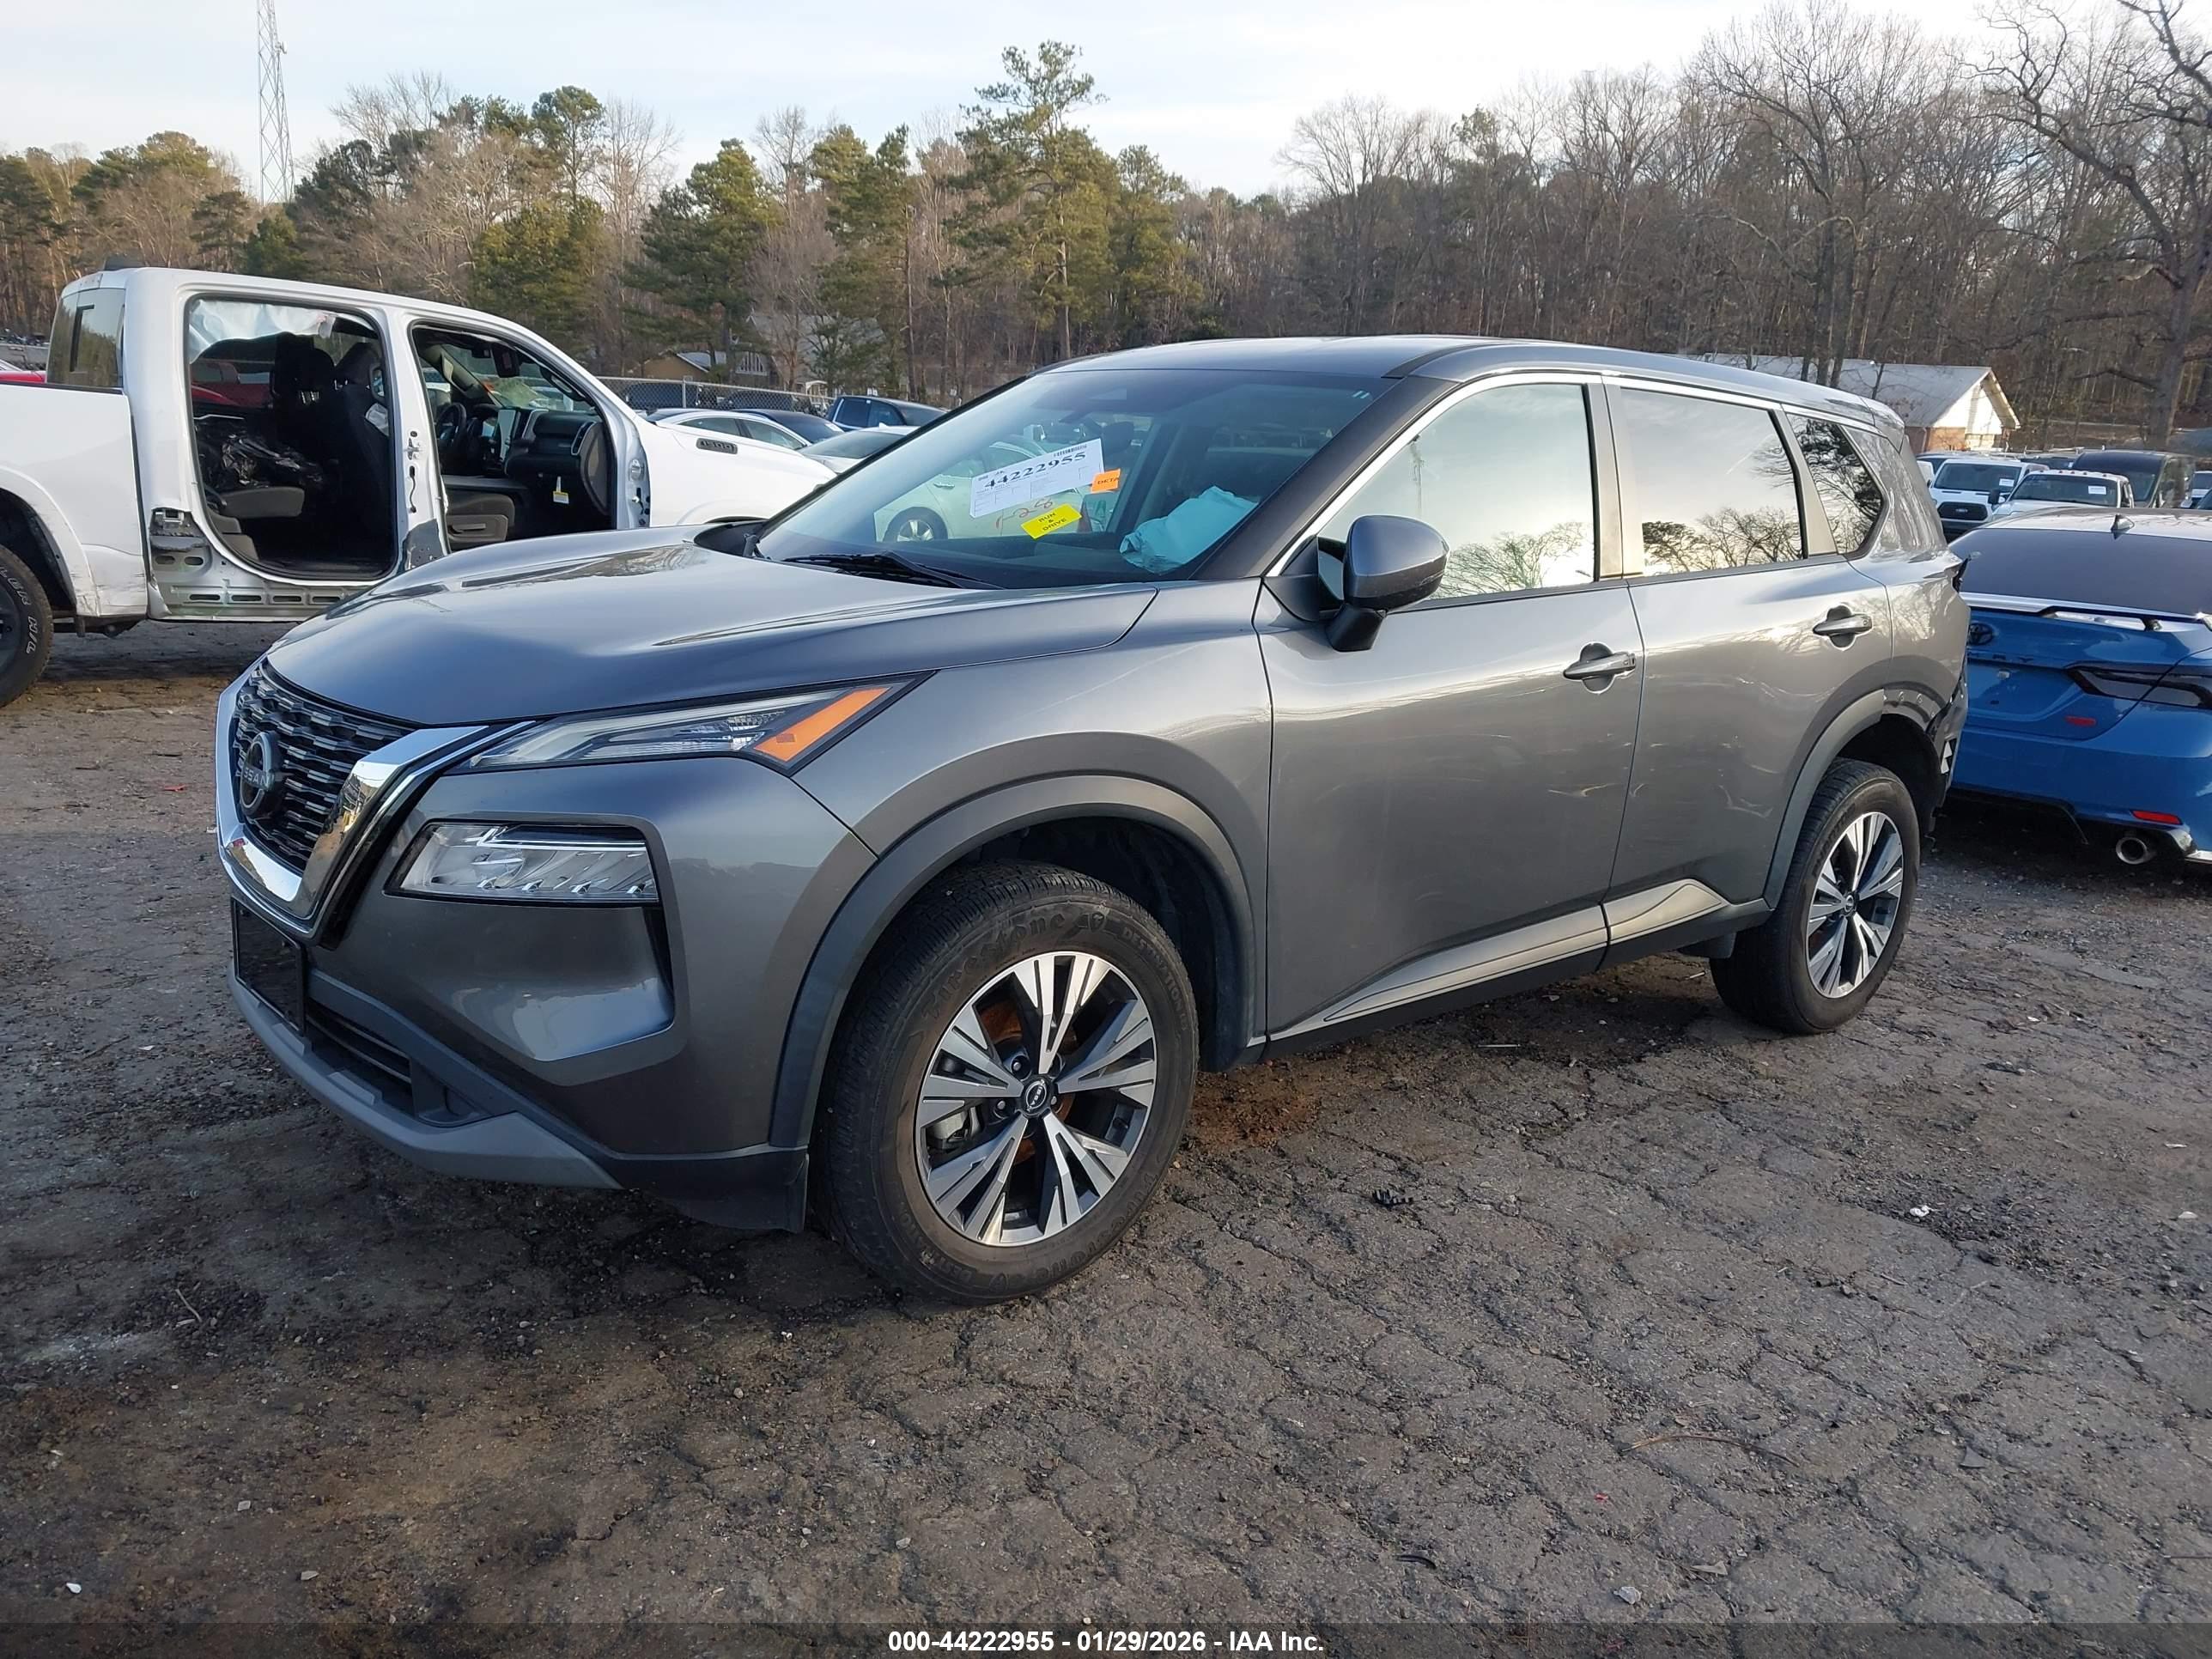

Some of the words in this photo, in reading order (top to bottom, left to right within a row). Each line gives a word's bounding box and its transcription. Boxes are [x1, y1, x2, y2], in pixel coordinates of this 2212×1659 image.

[985, 452, 1086, 488] 44222955
[1038, 512, 1056, 523] RUN
[1042, 518, 1066, 531] DRIVE
